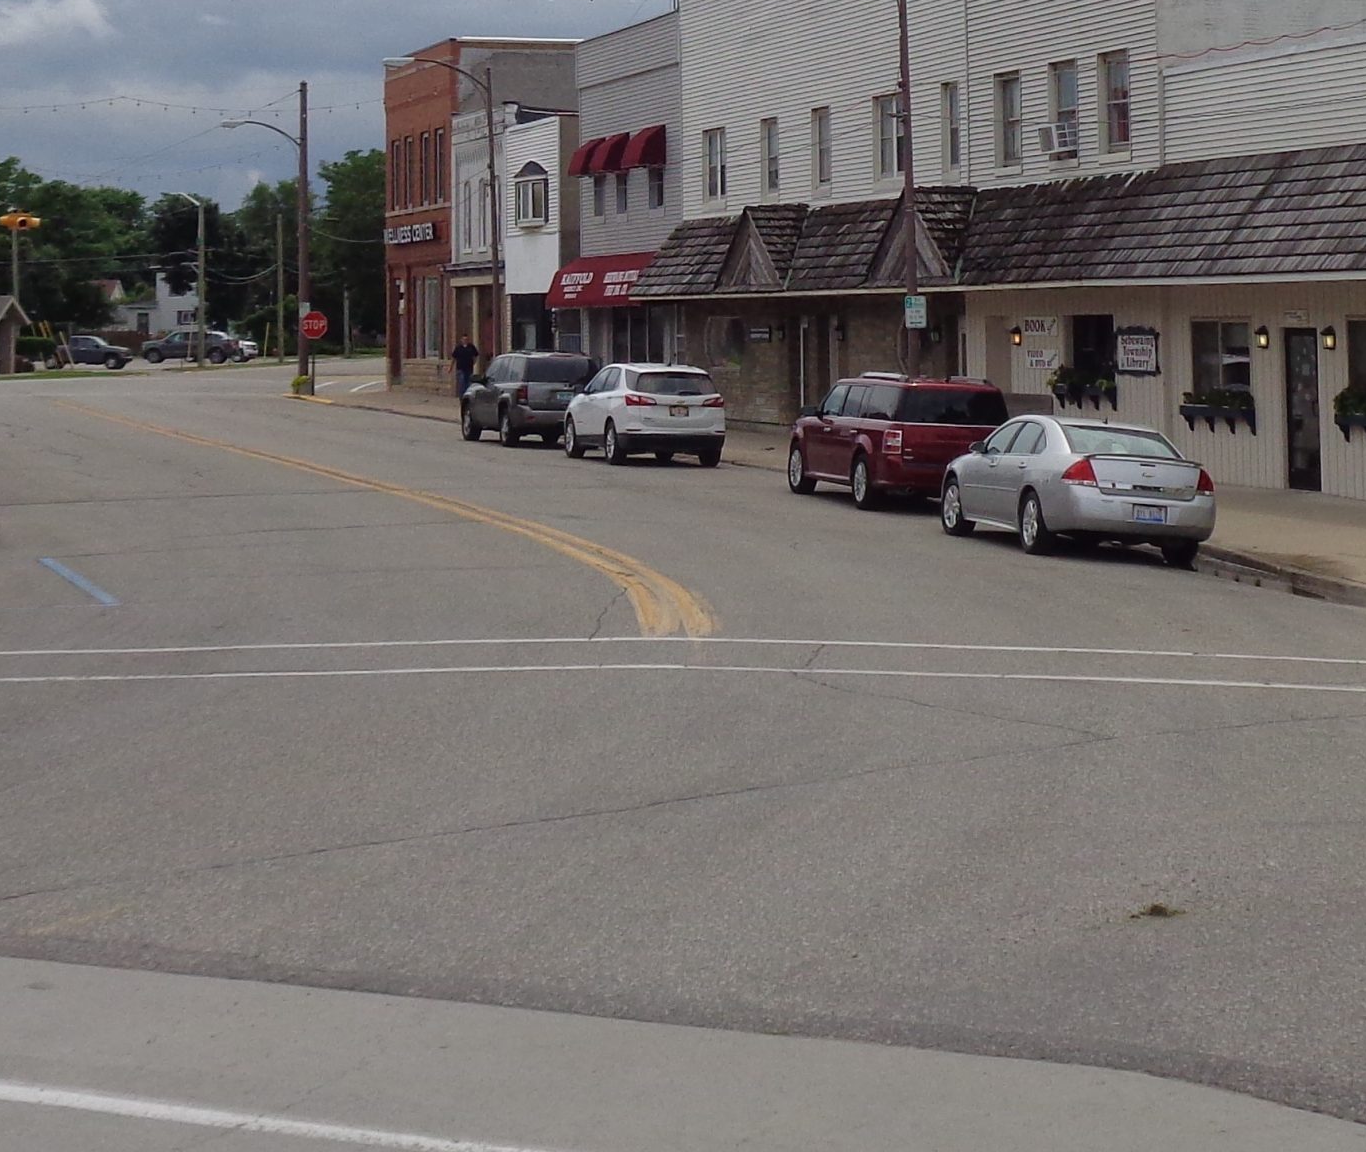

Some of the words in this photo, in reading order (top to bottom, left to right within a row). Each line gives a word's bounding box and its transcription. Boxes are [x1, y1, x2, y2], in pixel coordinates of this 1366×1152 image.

[412, 222, 434, 242] CENTER
[303, 320, 325, 330] STOP
[1024, 319, 1046, 333] BOOK
[1126, 357, 1150, 371] Library
